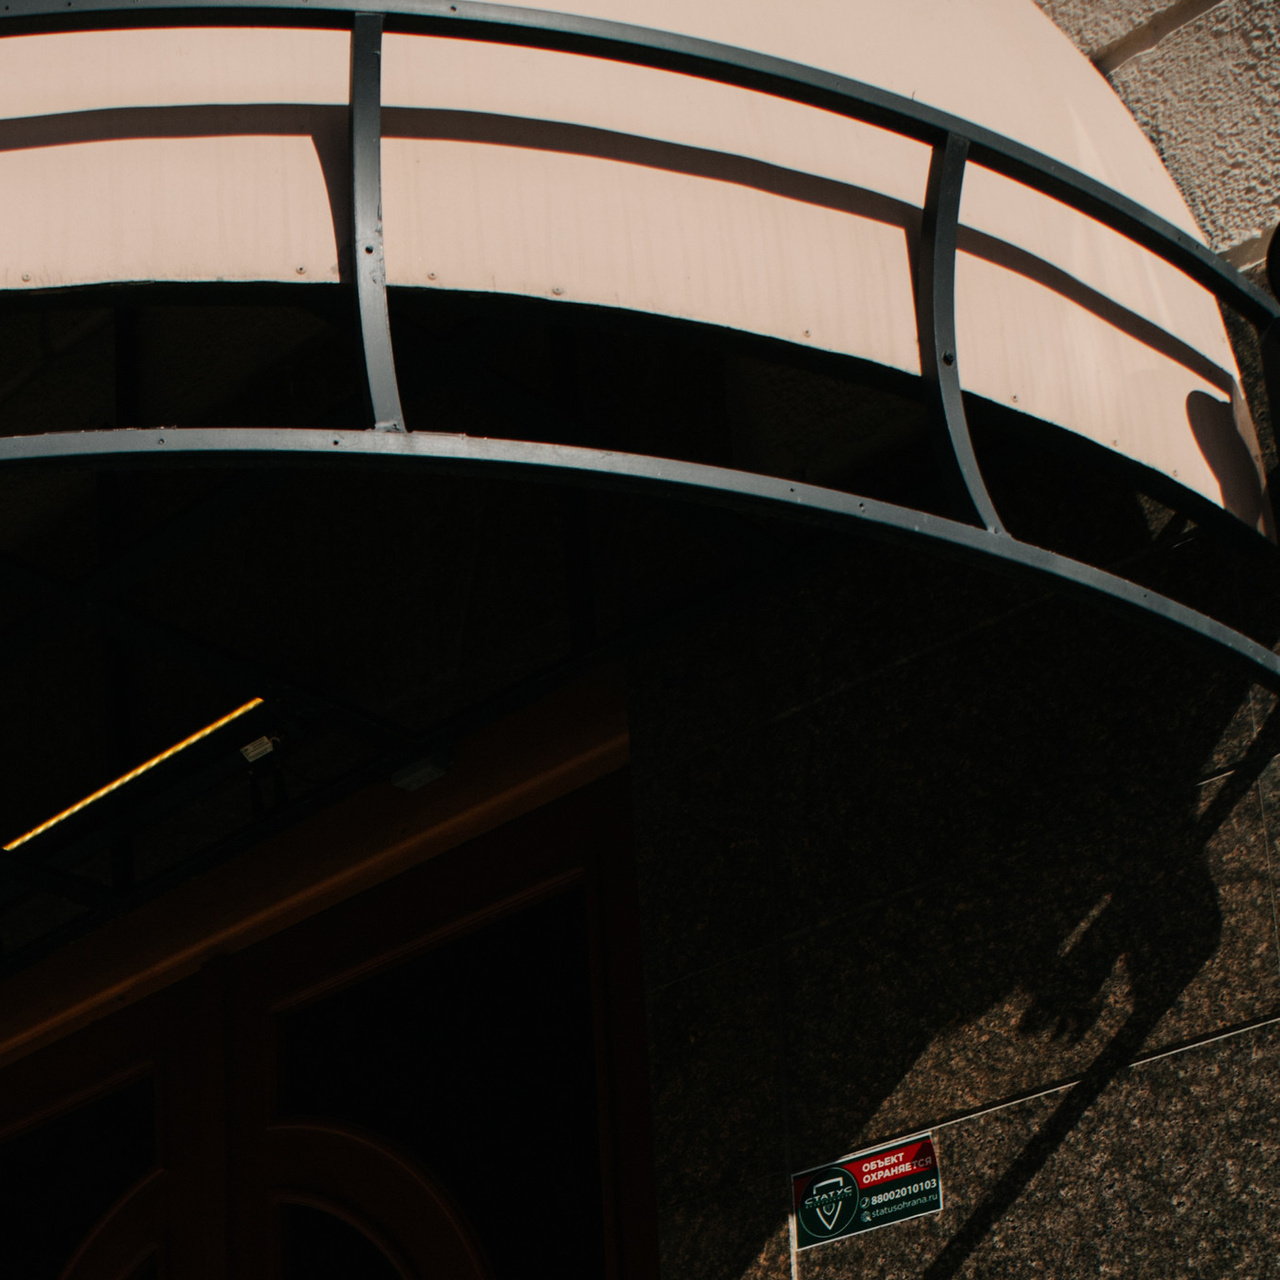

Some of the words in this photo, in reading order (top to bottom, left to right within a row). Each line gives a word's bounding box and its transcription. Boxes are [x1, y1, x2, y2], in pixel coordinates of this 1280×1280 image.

[862, 1153, 904, 1172] ОБЪЕКТ
[863, 1156, 932, 1183] ОХРАНЯЕТСЯ
[805, 1186, 852, 1205] СТАТУС
[871, 1179, 937, 1205] 88002010103
[872, 1194, 938, 1218] statusohrana.ru
